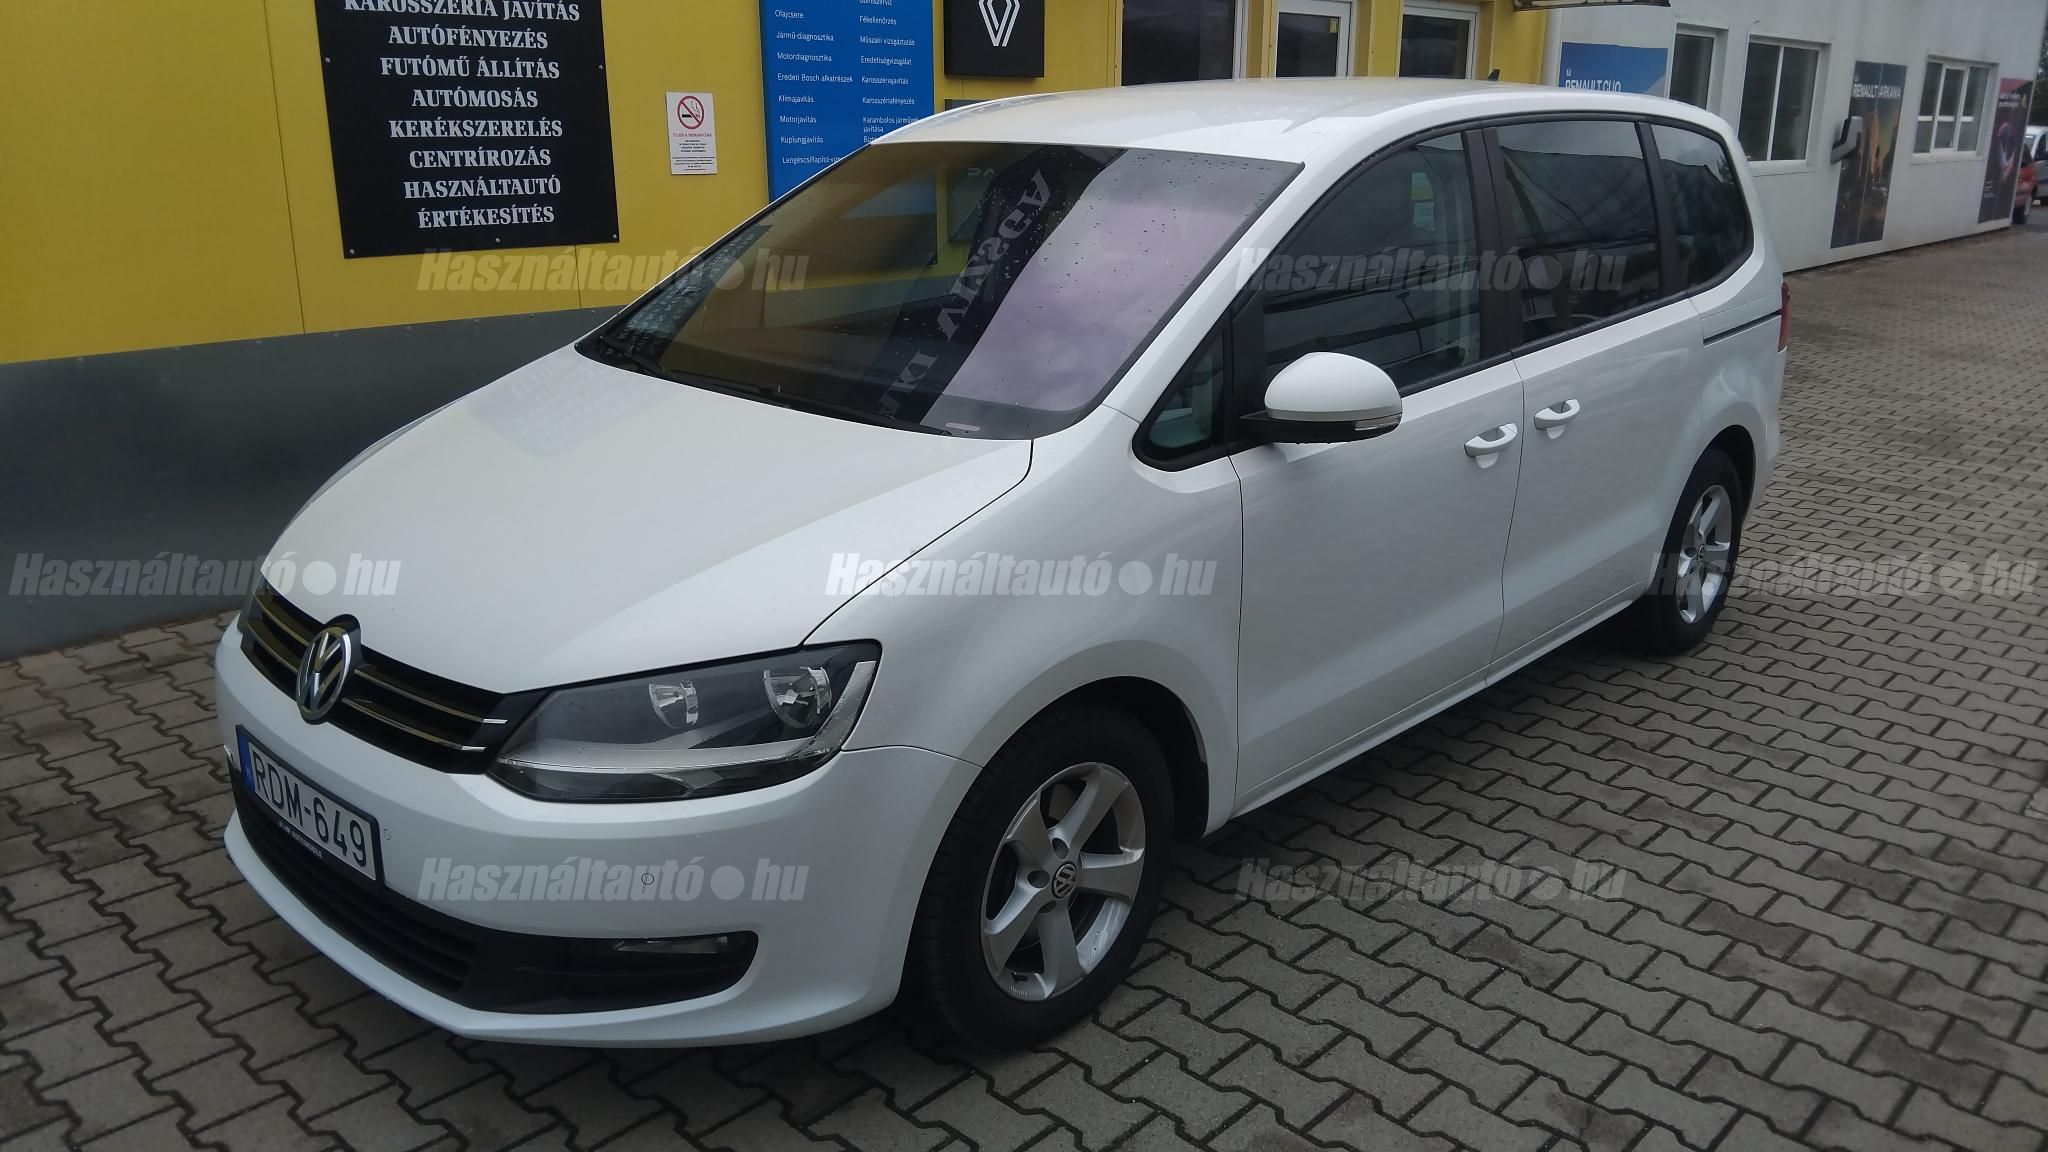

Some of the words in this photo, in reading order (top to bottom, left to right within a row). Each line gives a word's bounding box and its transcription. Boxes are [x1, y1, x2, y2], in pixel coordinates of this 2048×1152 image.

[503, 0, 580, 21] JAVÍTÁS
[774, 9, 804, 19] Olajcsere
[388, 23, 549, 49] AUTÓFÉNYEZÉS
[380, 55, 470, 77] FUTÓMŰ
[476, 57, 560, 79] ÁLLÍTÁS
[777, 52, 832, 62] Motordiagnosztika
[777, 72, 800, 81] Eredeti
[801, 73, 820, 82] Bosch
[411, 86, 538, 108] AUTÓMOSÁS
[388, 116, 563, 138] KERÉKSZERELÉS
[863, 116, 895, 124] Karambolos
[409, 145, 552, 168] CENTRÍROZÁS
[403, 174, 561, 199] HASZNÁLTAUTÓ
[417, 203, 555, 228] ÉRTÉKESÍTÉS
[252, 750, 367, 867] RDM-649
